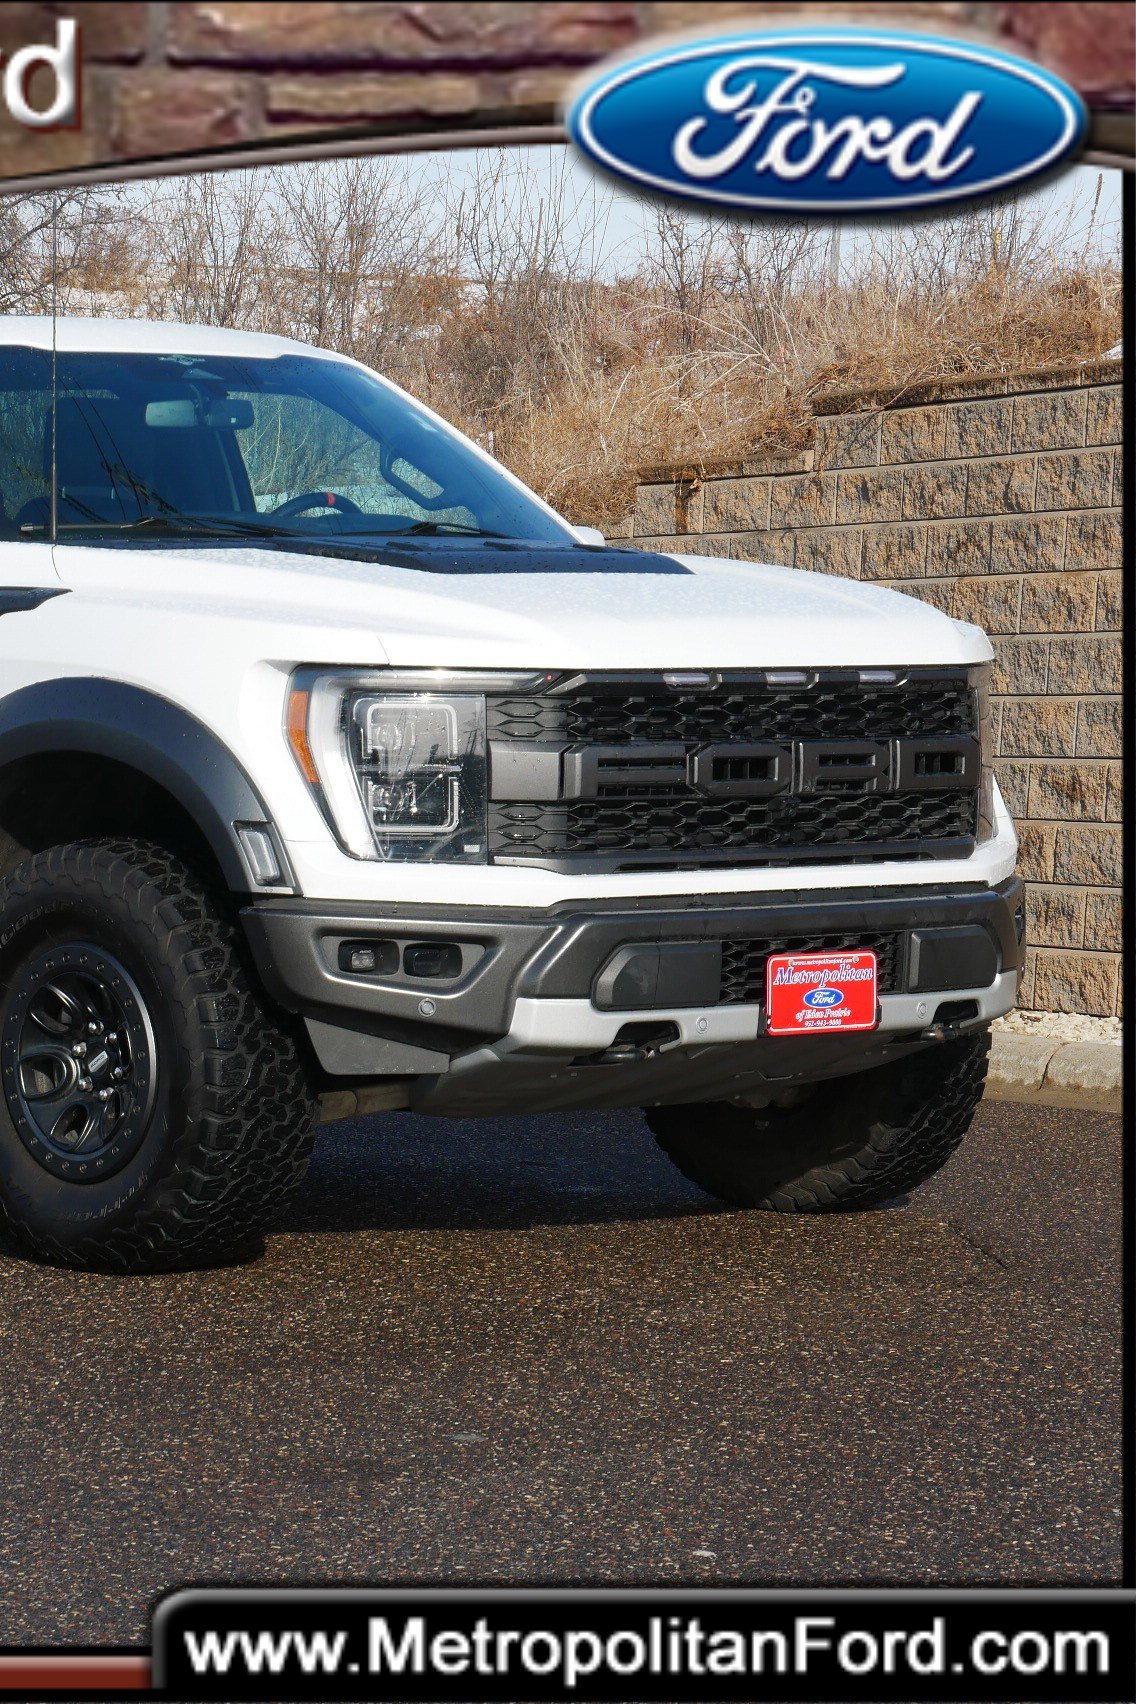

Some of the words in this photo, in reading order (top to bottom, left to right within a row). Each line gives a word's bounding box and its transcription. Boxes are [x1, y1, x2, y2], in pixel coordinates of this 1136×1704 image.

[565, 734, 981, 797] FORD
[773, 963, 873, 987] Metropolitan
[811, 991, 836, 1005] Ford
[794, 1009, 805, 1022] of
[804, 1008, 824, 1019] Eden
[825, 1007, 851, 1018] Prairie
